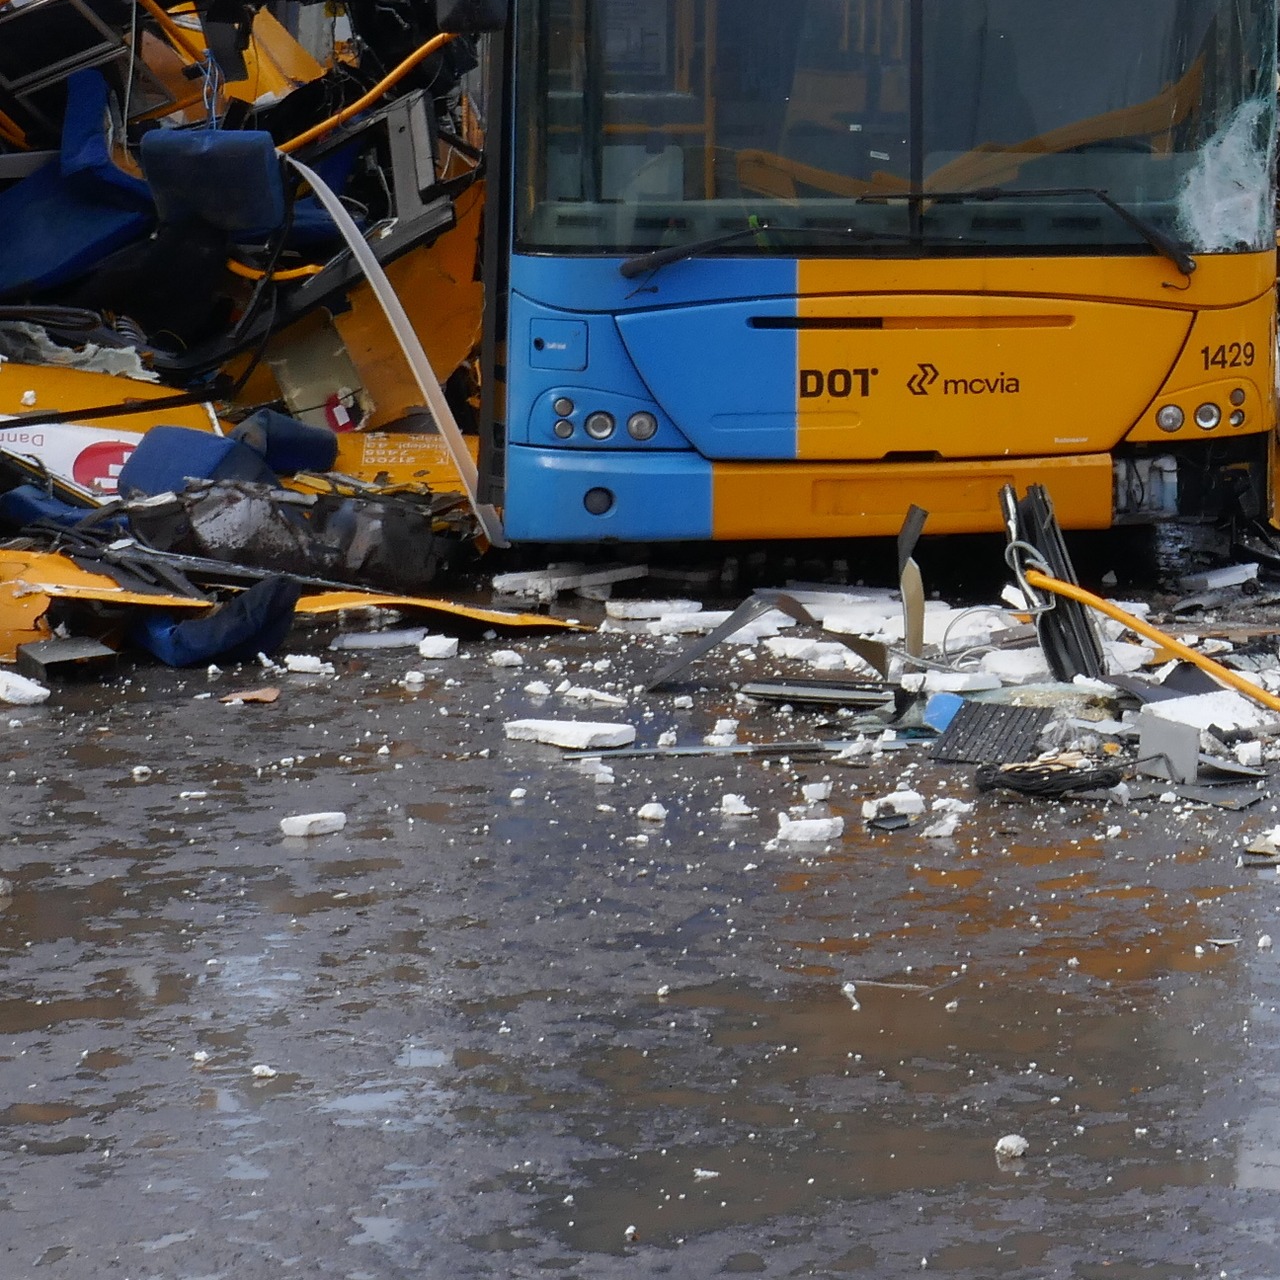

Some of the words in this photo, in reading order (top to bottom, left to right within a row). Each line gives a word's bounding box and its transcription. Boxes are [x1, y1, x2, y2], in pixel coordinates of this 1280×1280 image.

[1201, 341, 1255, 370] 1429
[799, 367, 879, 398] DOT
[943, 371, 1020, 395] movia
